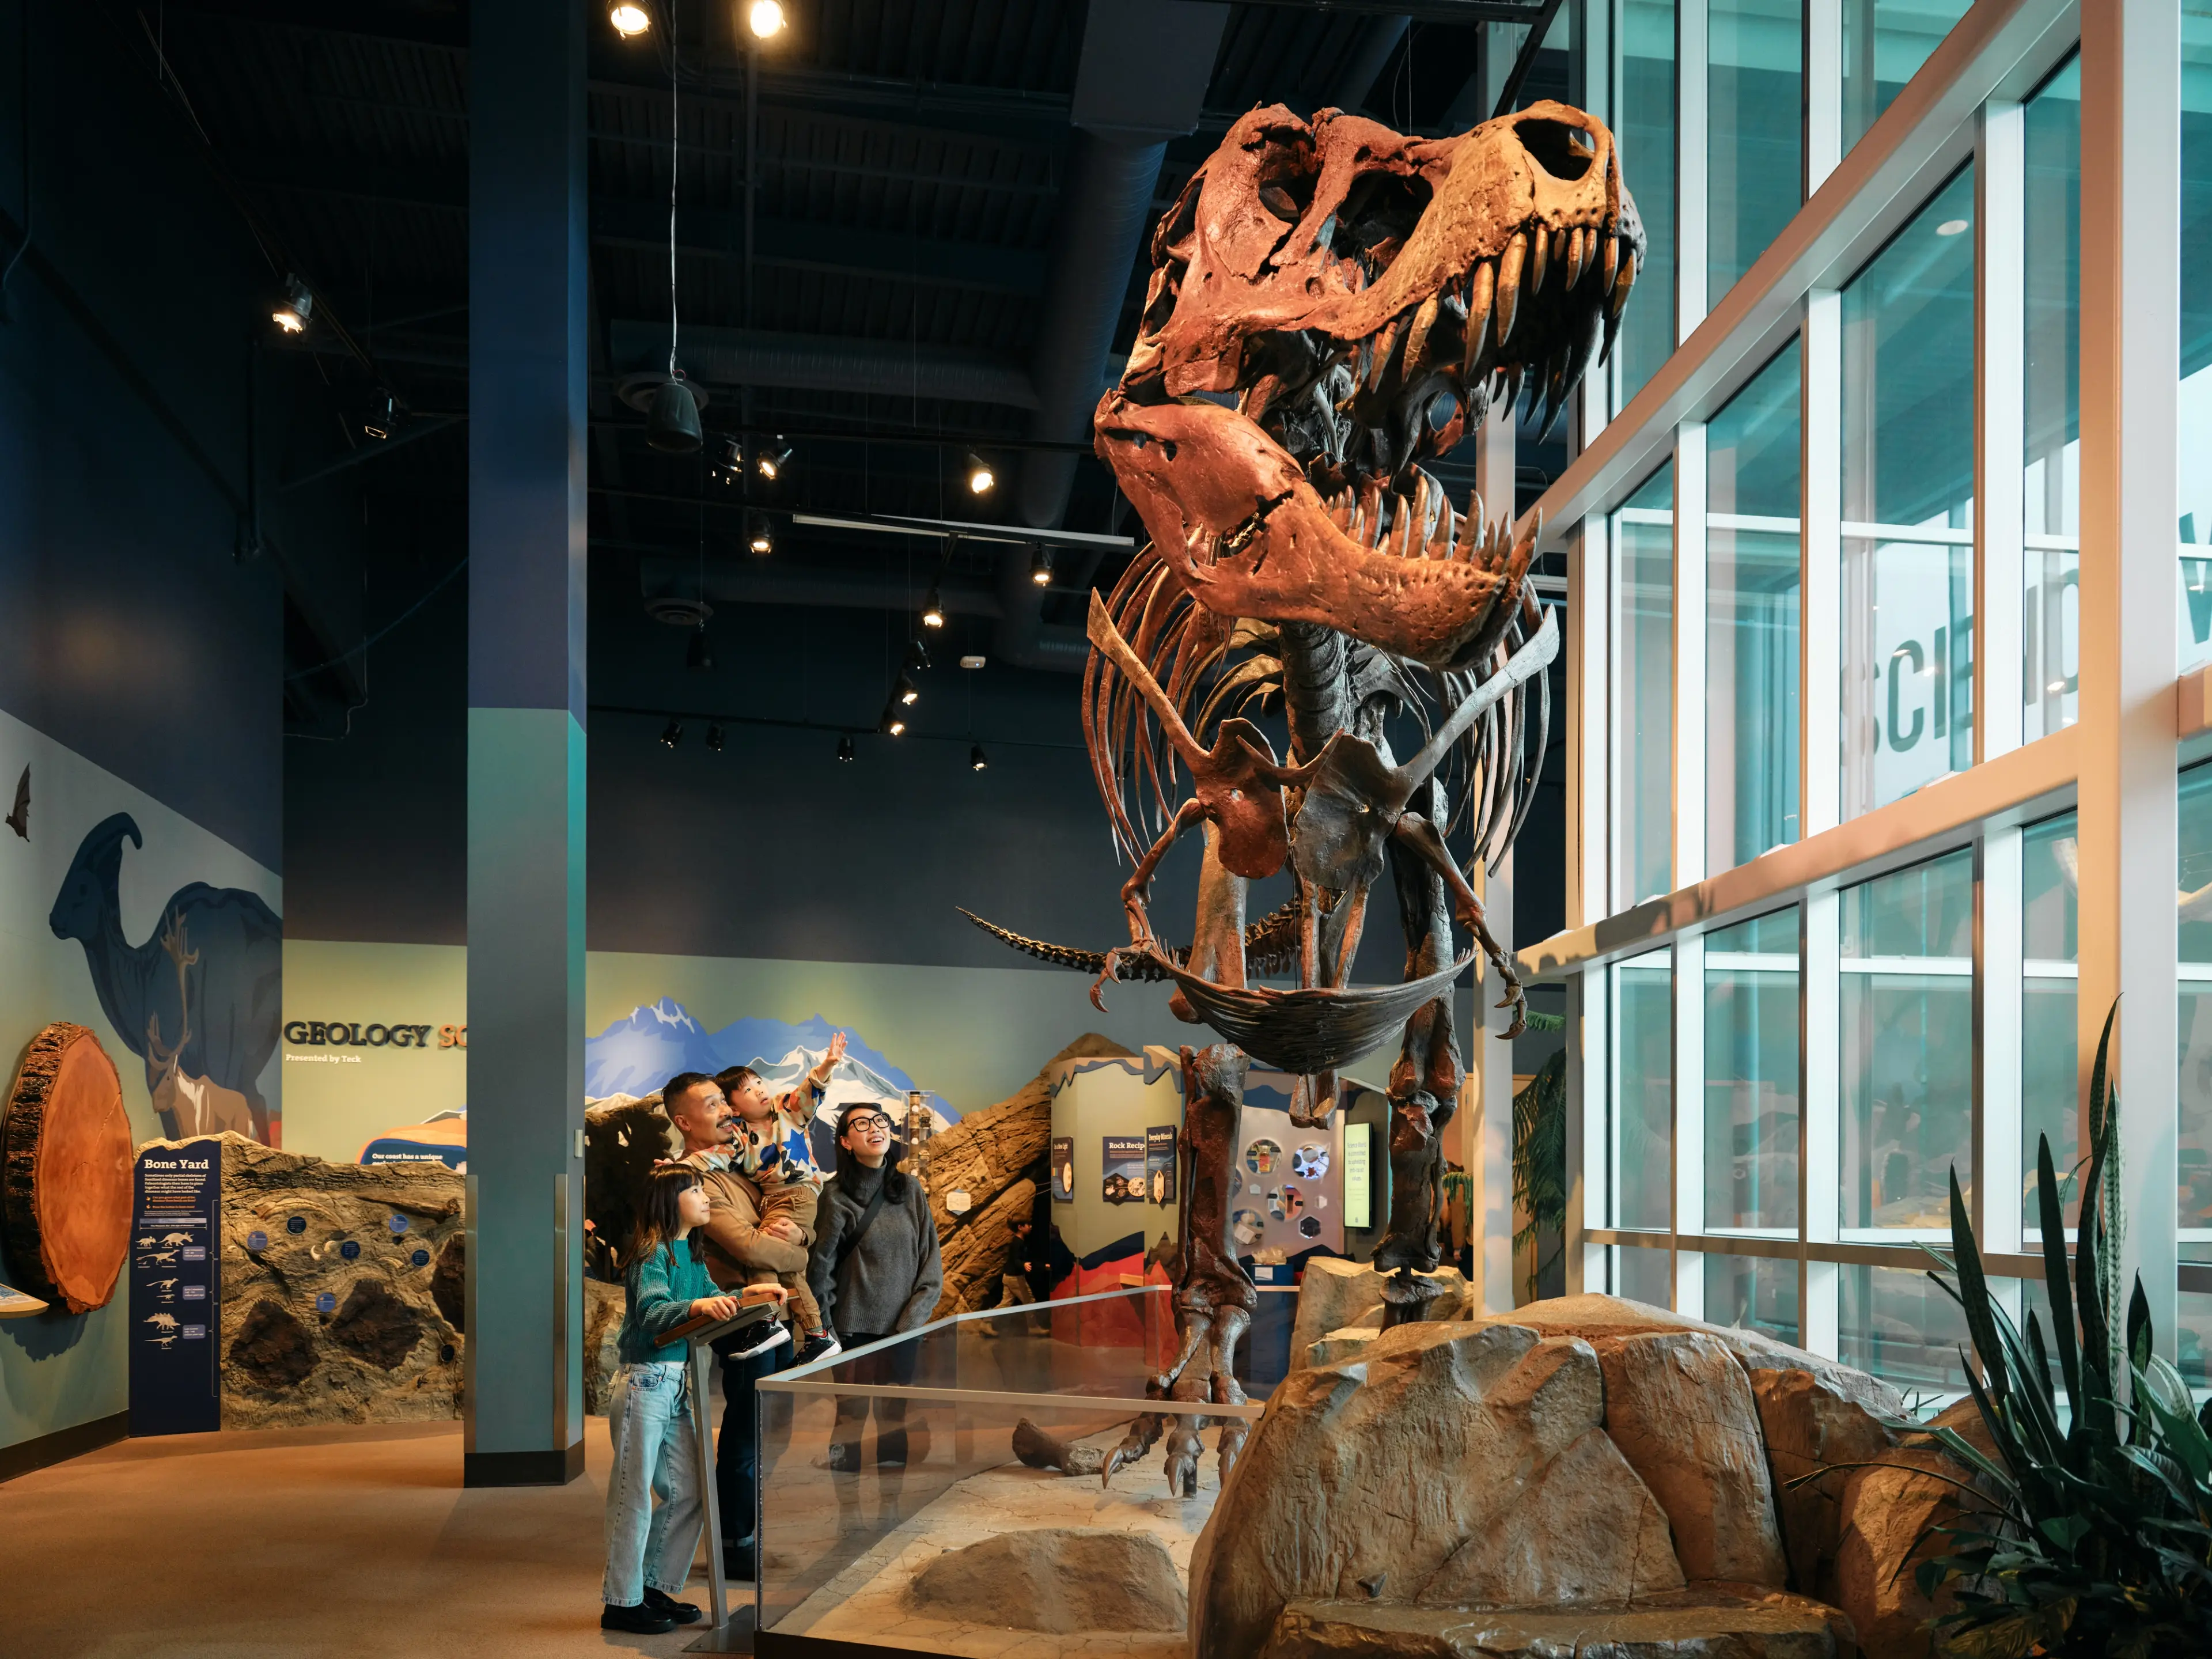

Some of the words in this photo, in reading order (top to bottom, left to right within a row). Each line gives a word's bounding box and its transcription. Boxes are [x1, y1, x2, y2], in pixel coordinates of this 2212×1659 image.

[283, 1021, 431, 1047] GEOLOGY
[329, 1054, 340, 1064] by
[1126, 1142, 1145, 1150] Recip
[144, 1159, 177, 1169] Bone
[179, 1159, 209, 1169] Yard
